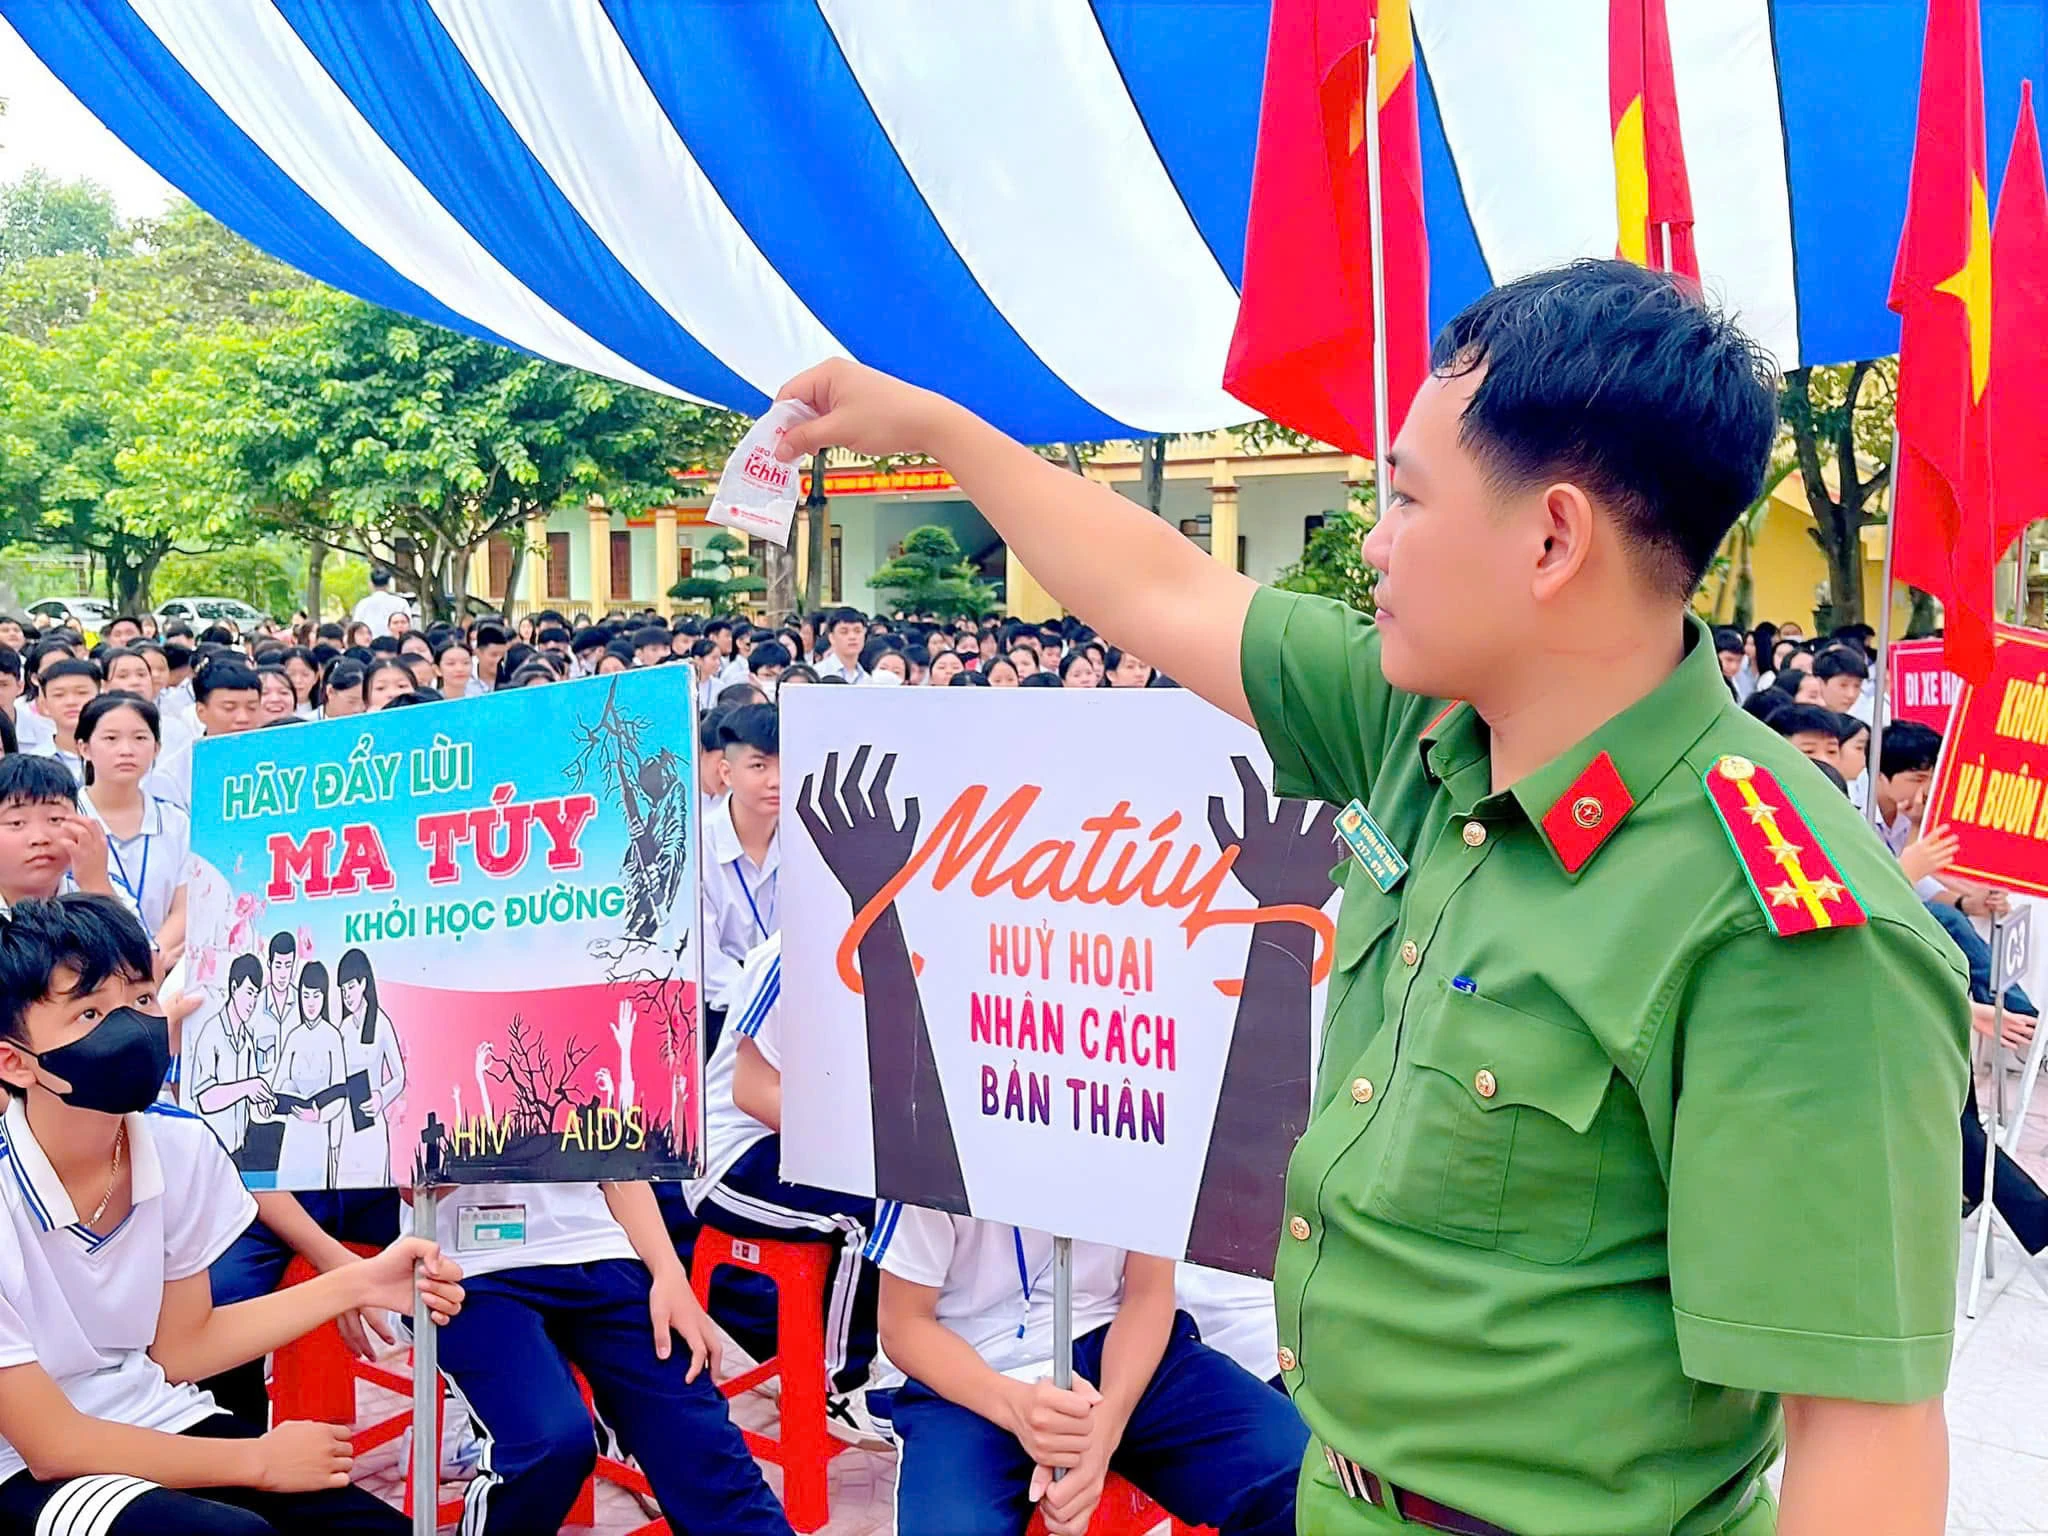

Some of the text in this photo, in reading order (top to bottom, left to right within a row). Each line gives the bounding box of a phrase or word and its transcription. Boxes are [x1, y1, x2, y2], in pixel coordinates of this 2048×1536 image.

[1921, 671, 1939, 705] XE
[224, 736, 473, 819] HÃY ĐẨY LÙI
[1979, 763, 2042, 836] BUÔN
[267, 785, 598, 904] MA TÚY
[345, 882, 626, 945] KHỎI HỌC ĐƯỜNG
[2006, 919, 2026, 977] C3
[989, 917, 1154, 996] HUỶ HOẠI
[970, 990, 1177, 1071] NHÂN CÁCH
[453, 1106, 645, 1157] HIV AIDS
[981, 1058, 1167, 1146] BẢN THÂN
